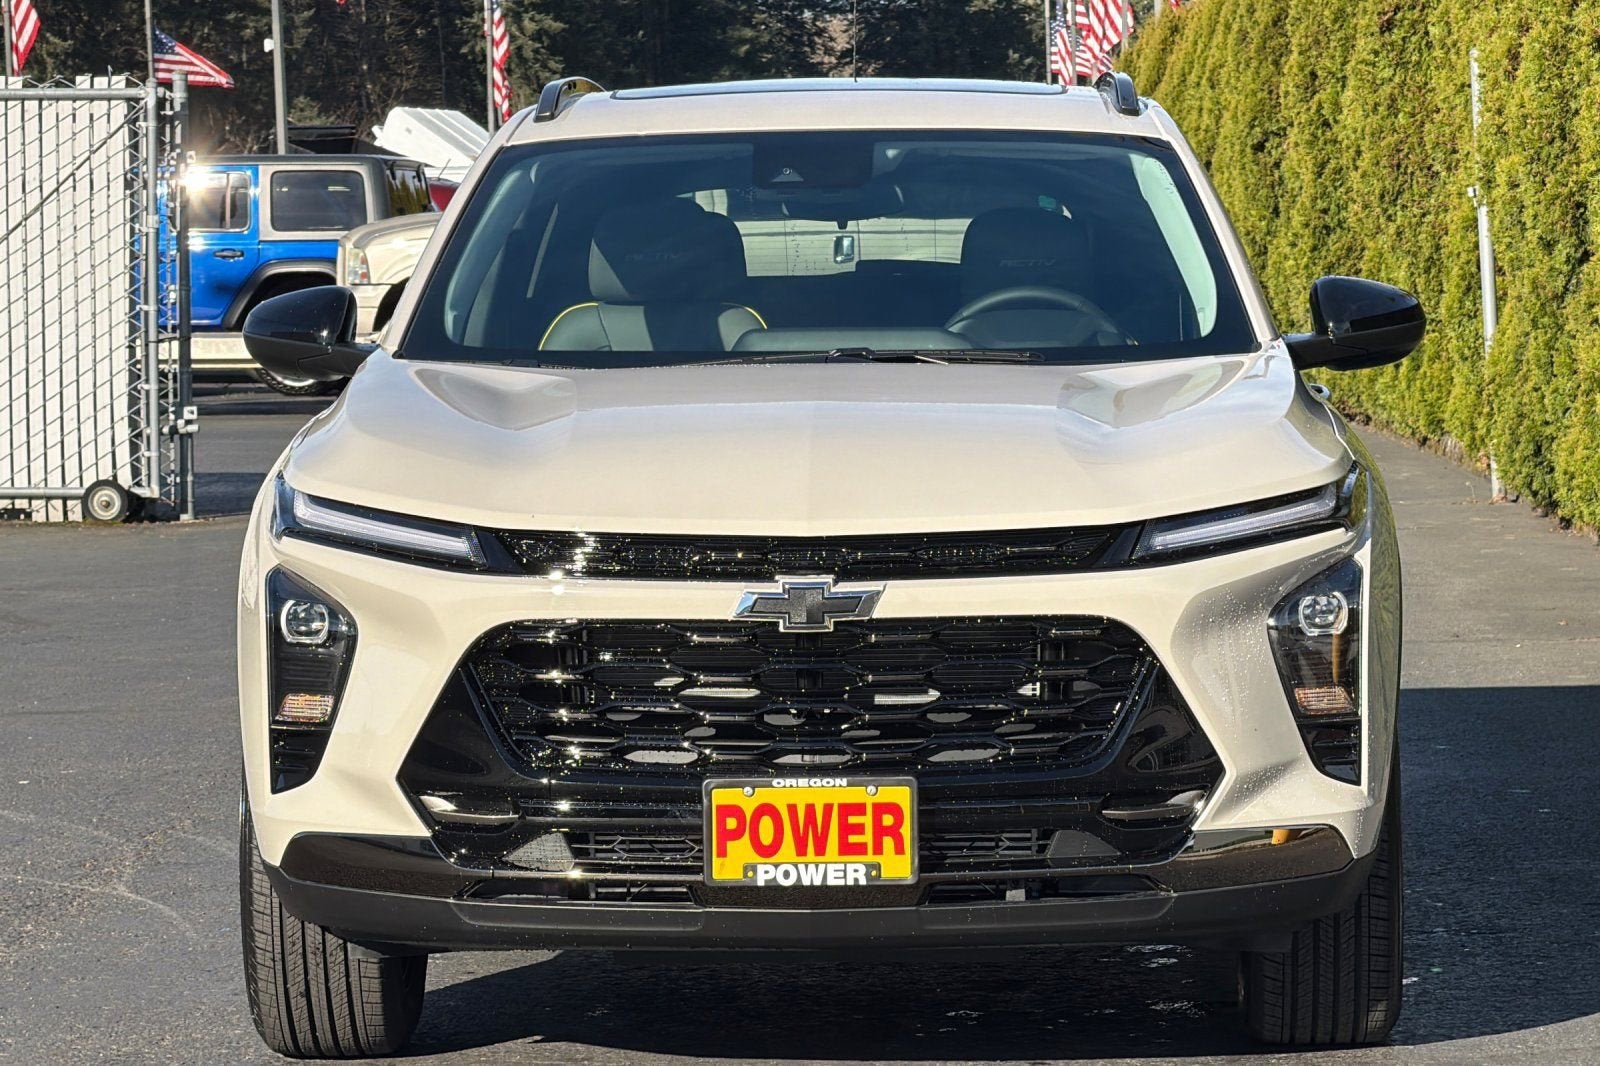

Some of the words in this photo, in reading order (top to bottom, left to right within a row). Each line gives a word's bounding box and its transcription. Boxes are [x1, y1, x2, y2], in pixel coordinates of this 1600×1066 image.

[771, 778, 847, 788] OREGON
[715, 802, 906, 859] POWER
[756, 864, 867, 886] POWER
